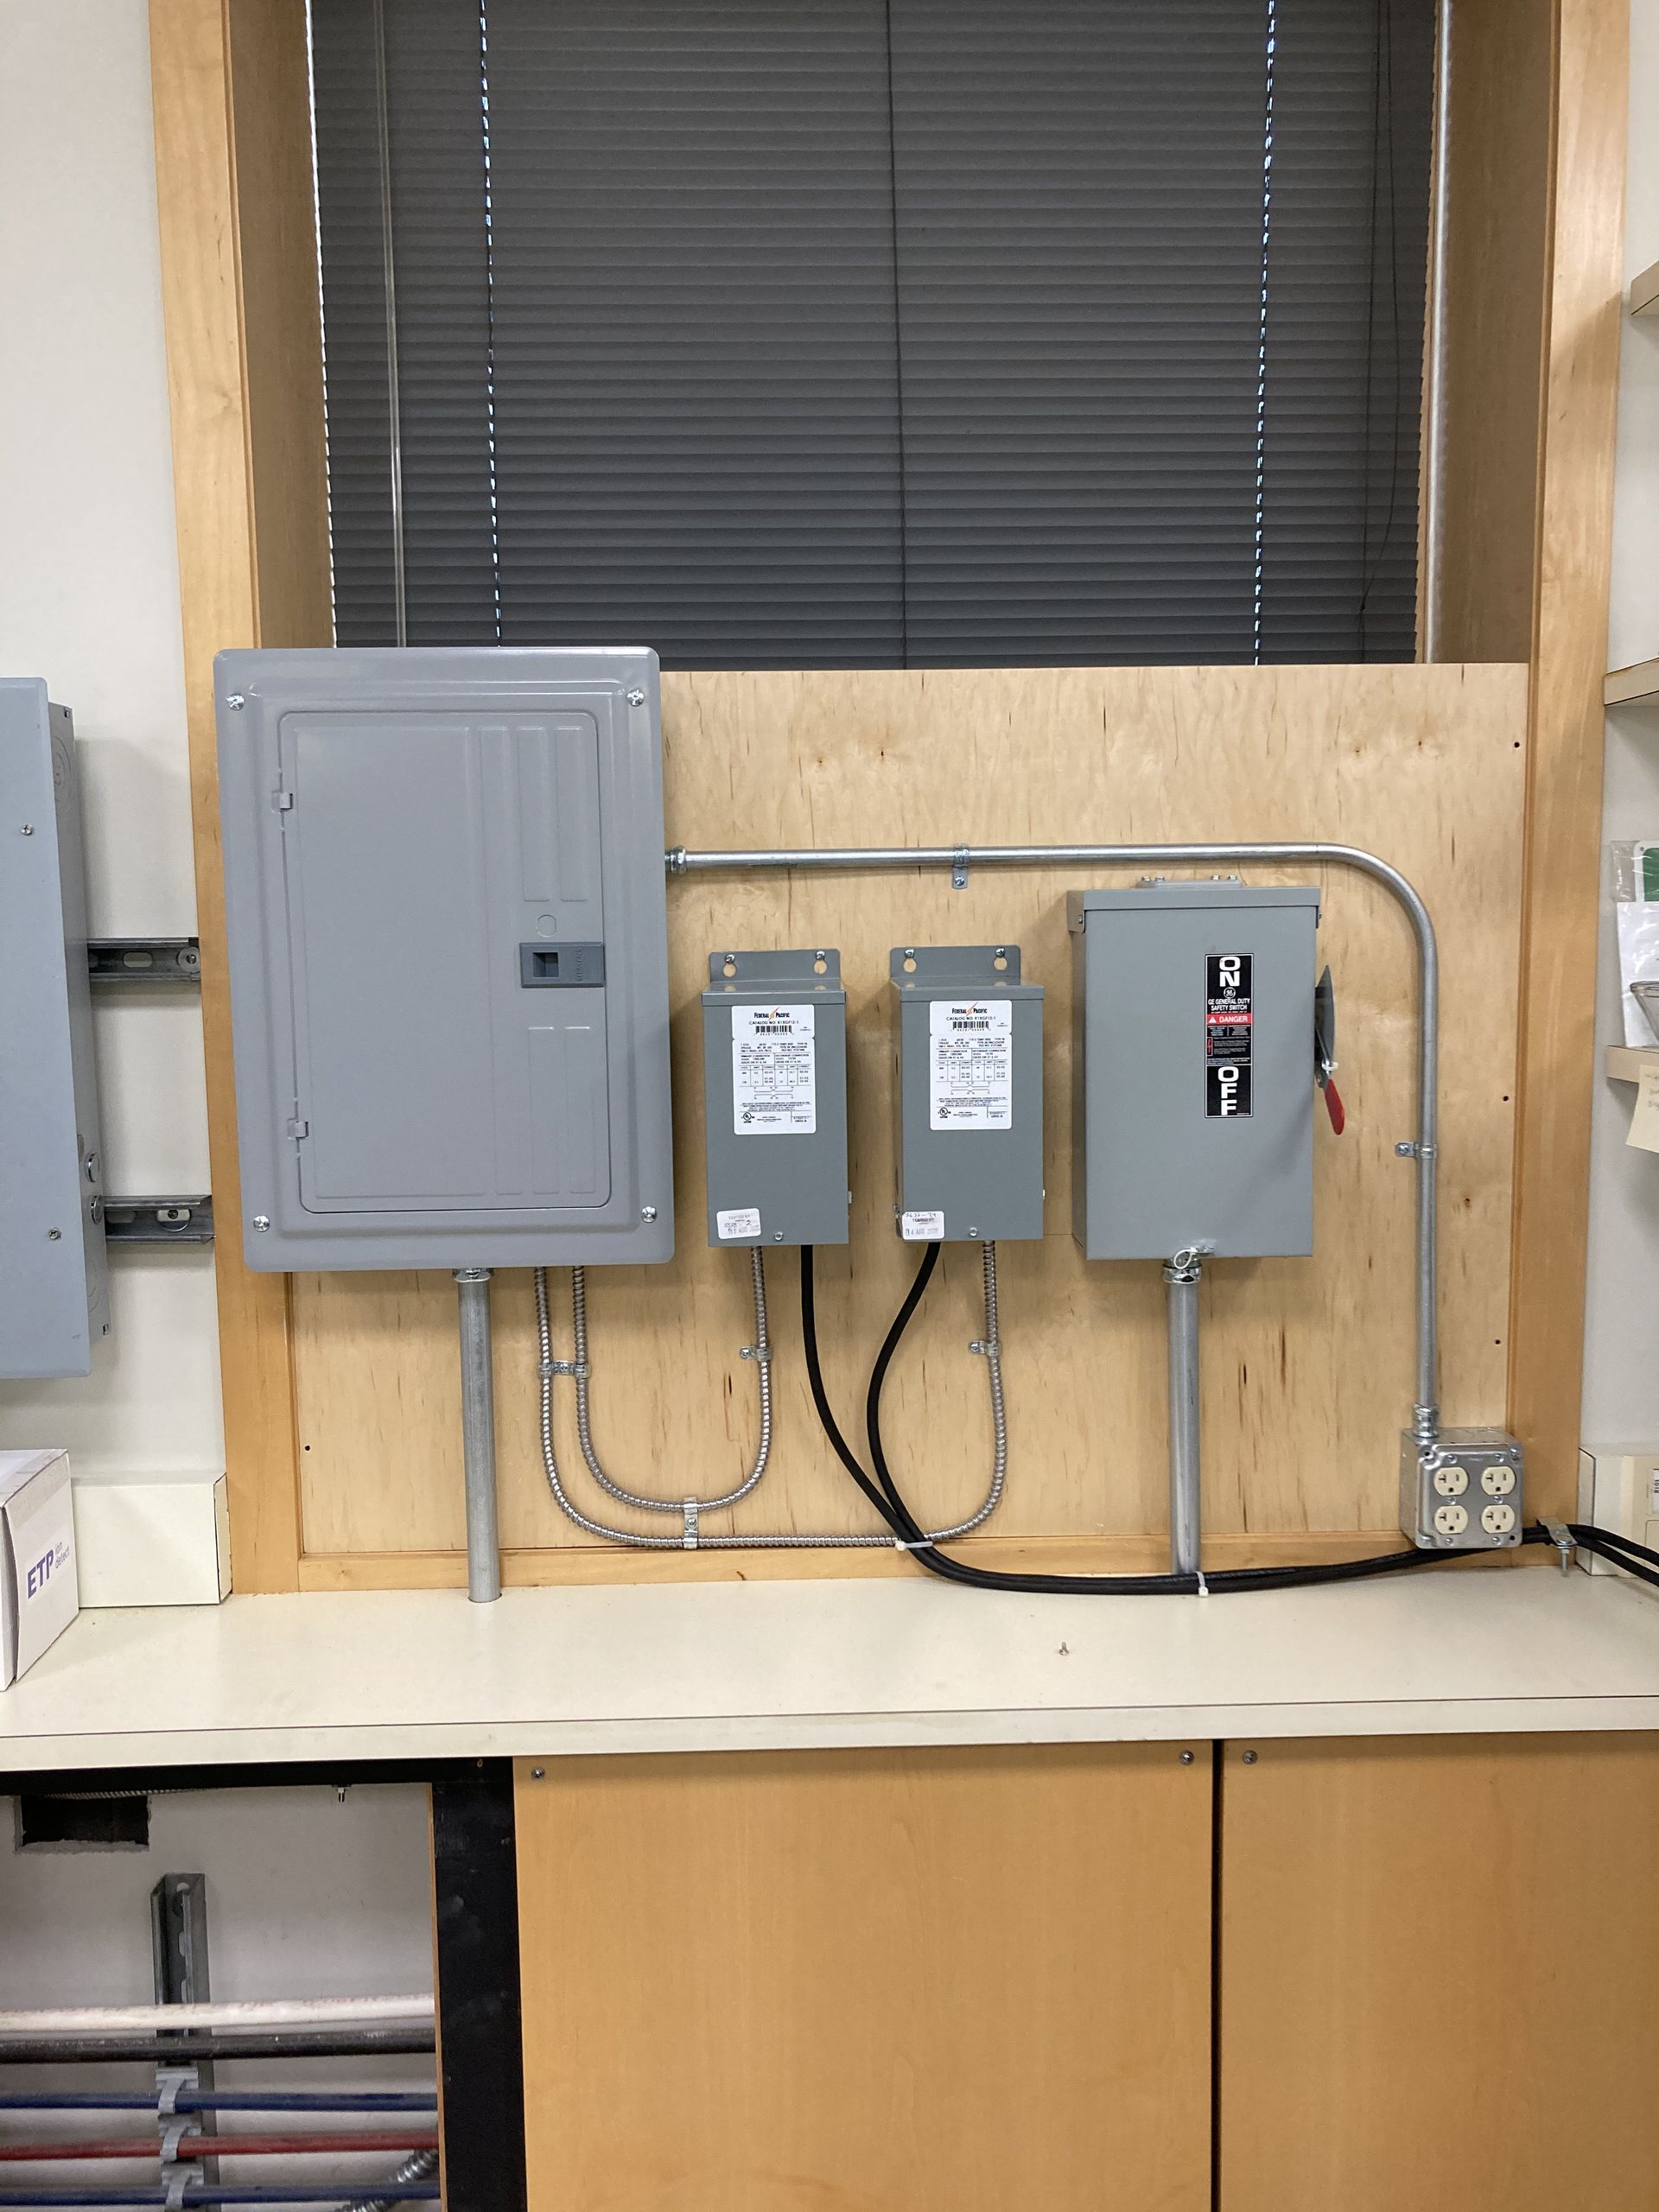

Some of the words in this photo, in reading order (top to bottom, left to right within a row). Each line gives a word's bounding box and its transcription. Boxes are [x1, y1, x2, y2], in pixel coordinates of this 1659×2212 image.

[1219, 956, 1241, 987] ON
[1217, 1065, 1239, 1116] OFF
[28, 1549, 54, 1599] ETP
